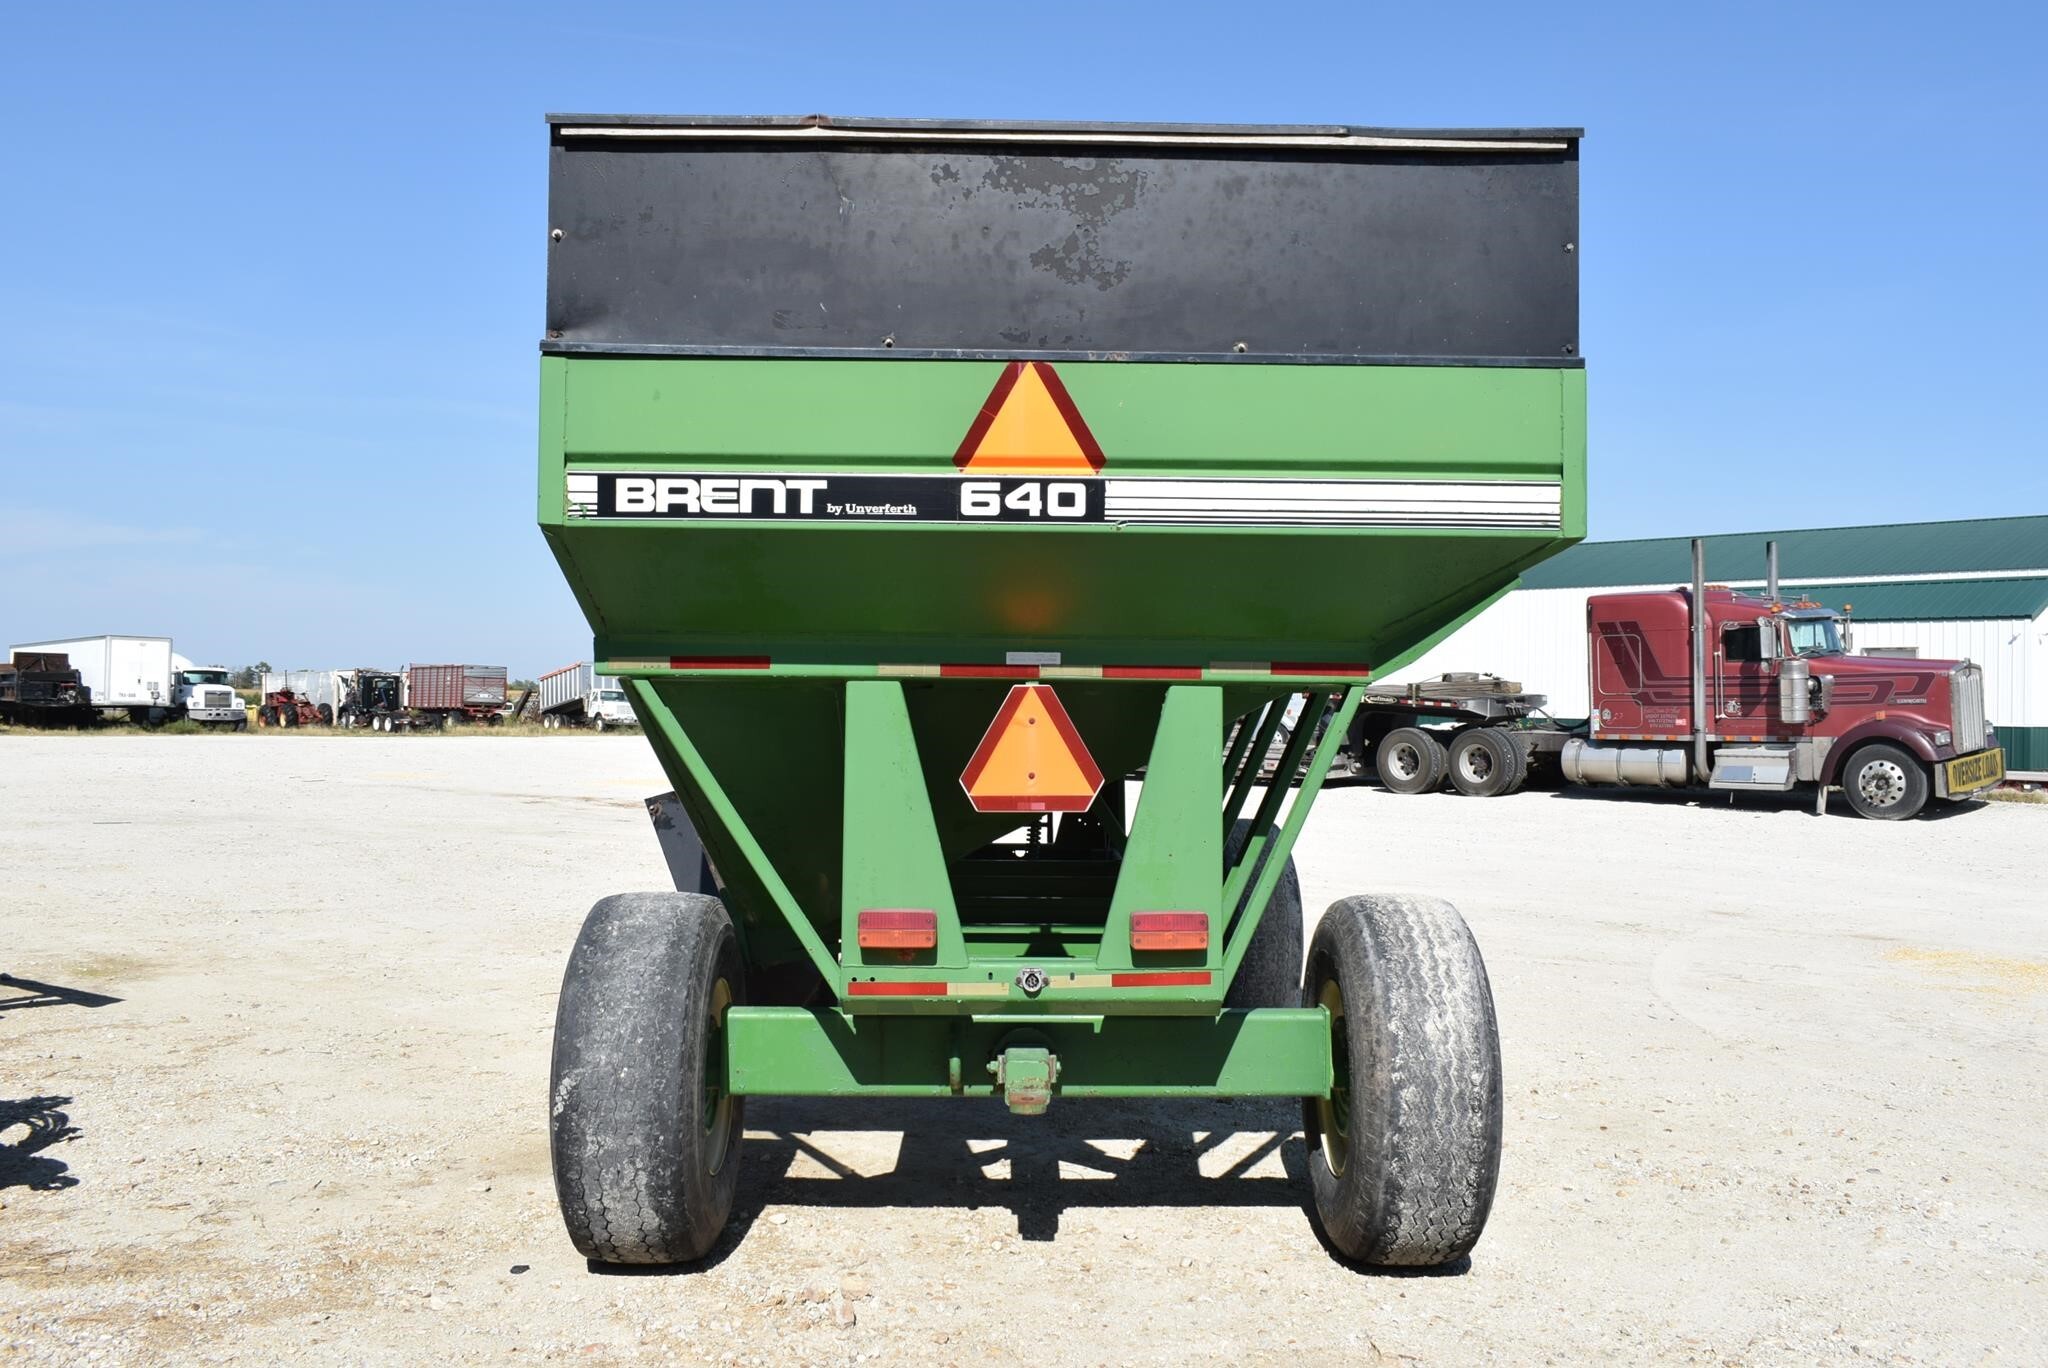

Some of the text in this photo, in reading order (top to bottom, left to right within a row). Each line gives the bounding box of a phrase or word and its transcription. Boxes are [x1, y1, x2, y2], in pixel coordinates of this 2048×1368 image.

[616, 478, 1086, 517] BRENT by Unverferth 640
[1953, 757, 1981, 787] OVERSIZE
